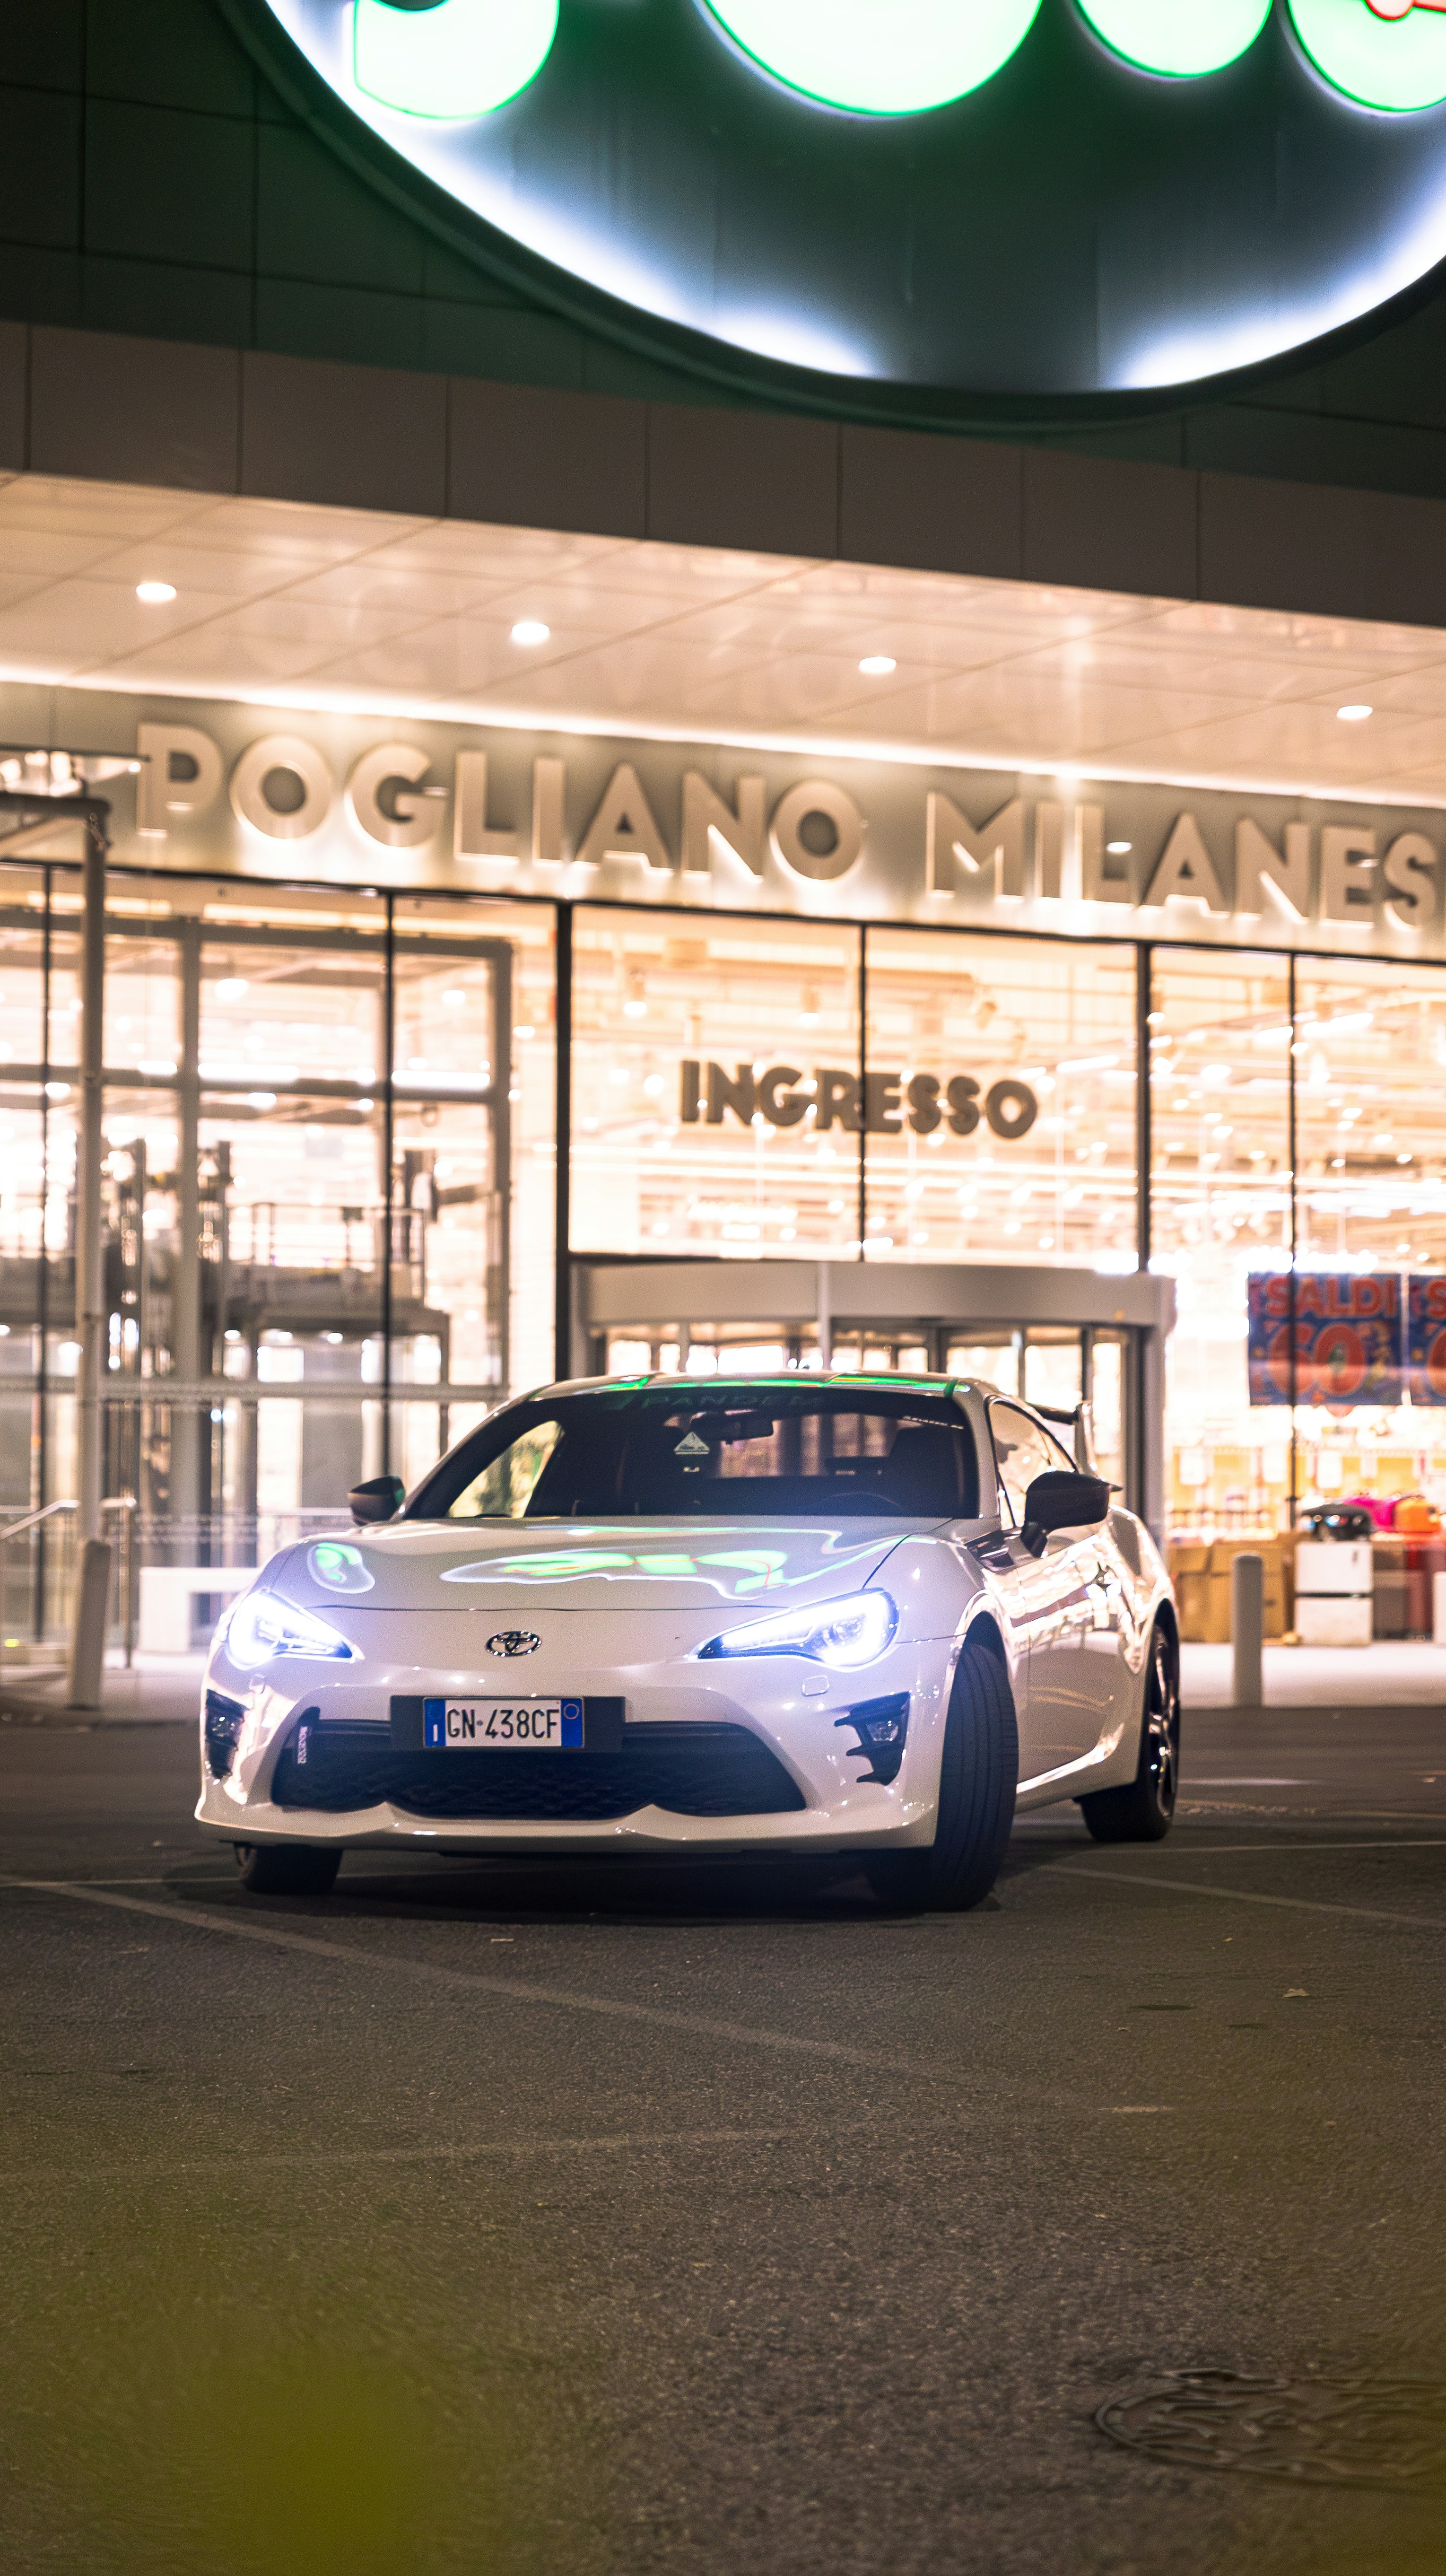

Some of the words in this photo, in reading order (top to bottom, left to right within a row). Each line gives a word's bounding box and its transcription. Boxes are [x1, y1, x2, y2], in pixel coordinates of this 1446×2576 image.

[137, 722, 866, 883] POGLIANO
[681, 1061, 1038, 1139] INGRESSO
[1264, 1276, 1396, 1318] SALDI
